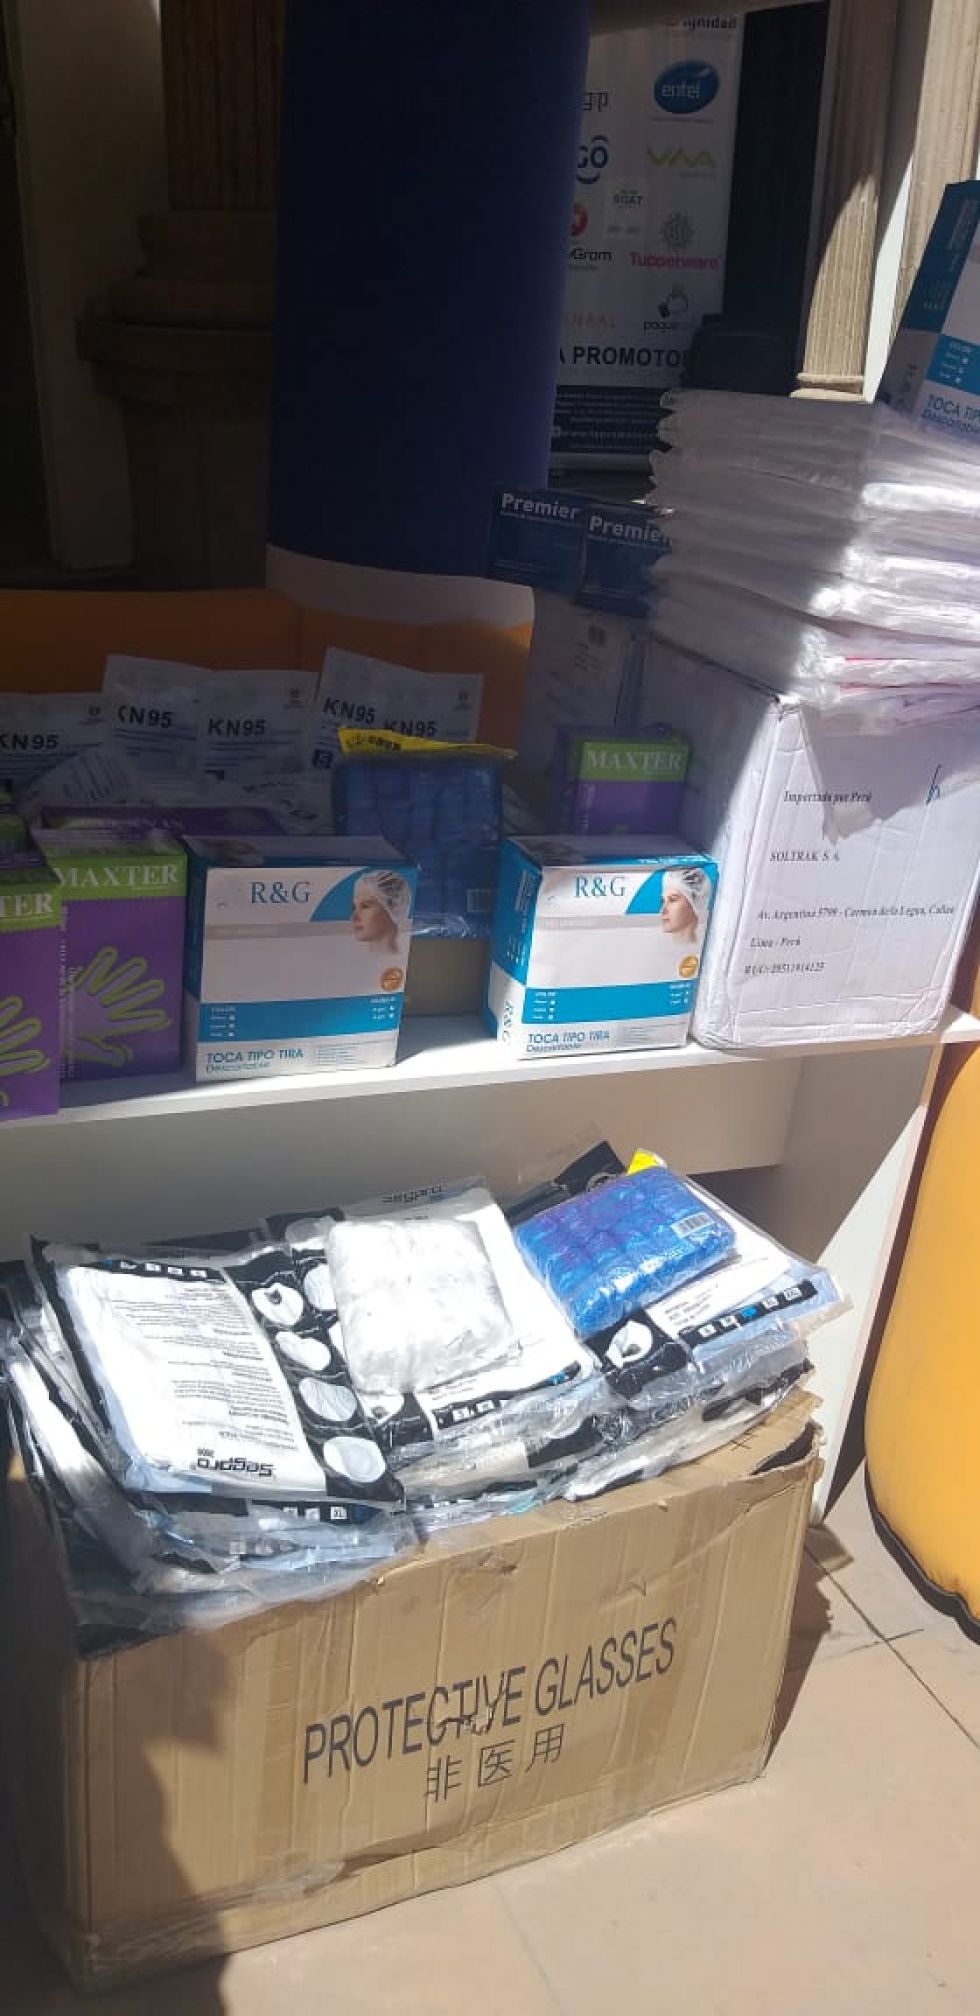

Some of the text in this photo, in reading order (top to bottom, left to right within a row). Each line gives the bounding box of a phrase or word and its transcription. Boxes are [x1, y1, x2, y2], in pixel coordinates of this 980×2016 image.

[661, 82, 700, 99] entel
[629, 251, 720, 269] Tupperware
[502, 492, 580, 520] Premier
[323, 697, 376, 723] KN95
[208, 718, 265, 737] KN95
[586, 749, 682, 770] MAXTER
[56, 863, 180, 888] MAXTER
[251, 881, 311, 904] R&G
[574, 876, 626, 897] R&G
[528, 1032, 559, 1044] TOCA
[562, 1031, 585, 1042] TIPO
[589, 1029, 610, 1040] TIRA
[206, 1049, 243, 1064] TOCA
[247, 1049, 275, 1061] TIPO
[279, 1048, 304, 1059] TIRA
[197, 1457, 274, 1477] Segpro
[304, 1616, 678, 1786] PROTECTIVE GLASSES
[423, 1723, 566, 1803] 非医用
